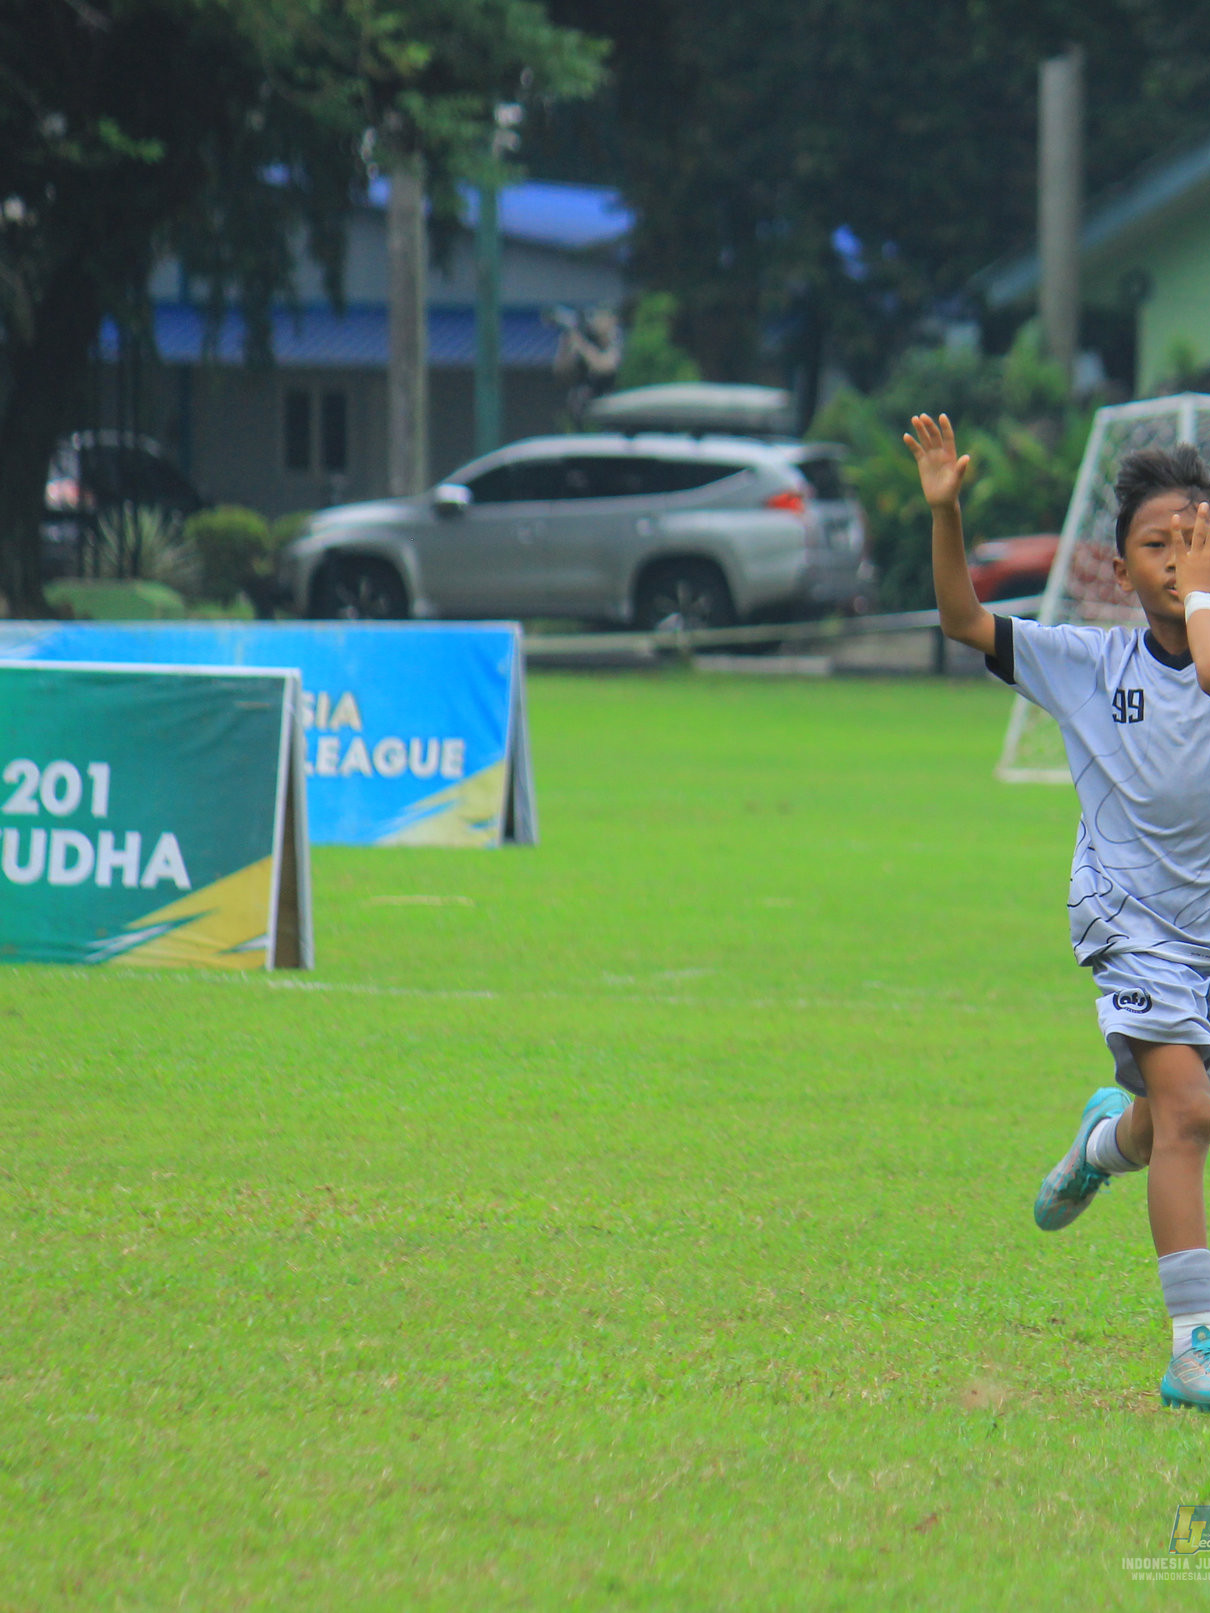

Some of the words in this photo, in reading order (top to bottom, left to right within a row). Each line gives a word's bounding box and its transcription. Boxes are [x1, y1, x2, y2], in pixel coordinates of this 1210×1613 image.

[1112, 688, 1145, 724] 99
[0, 757, 110, 819] 201
[0, 826, 192, 890] UDHA
